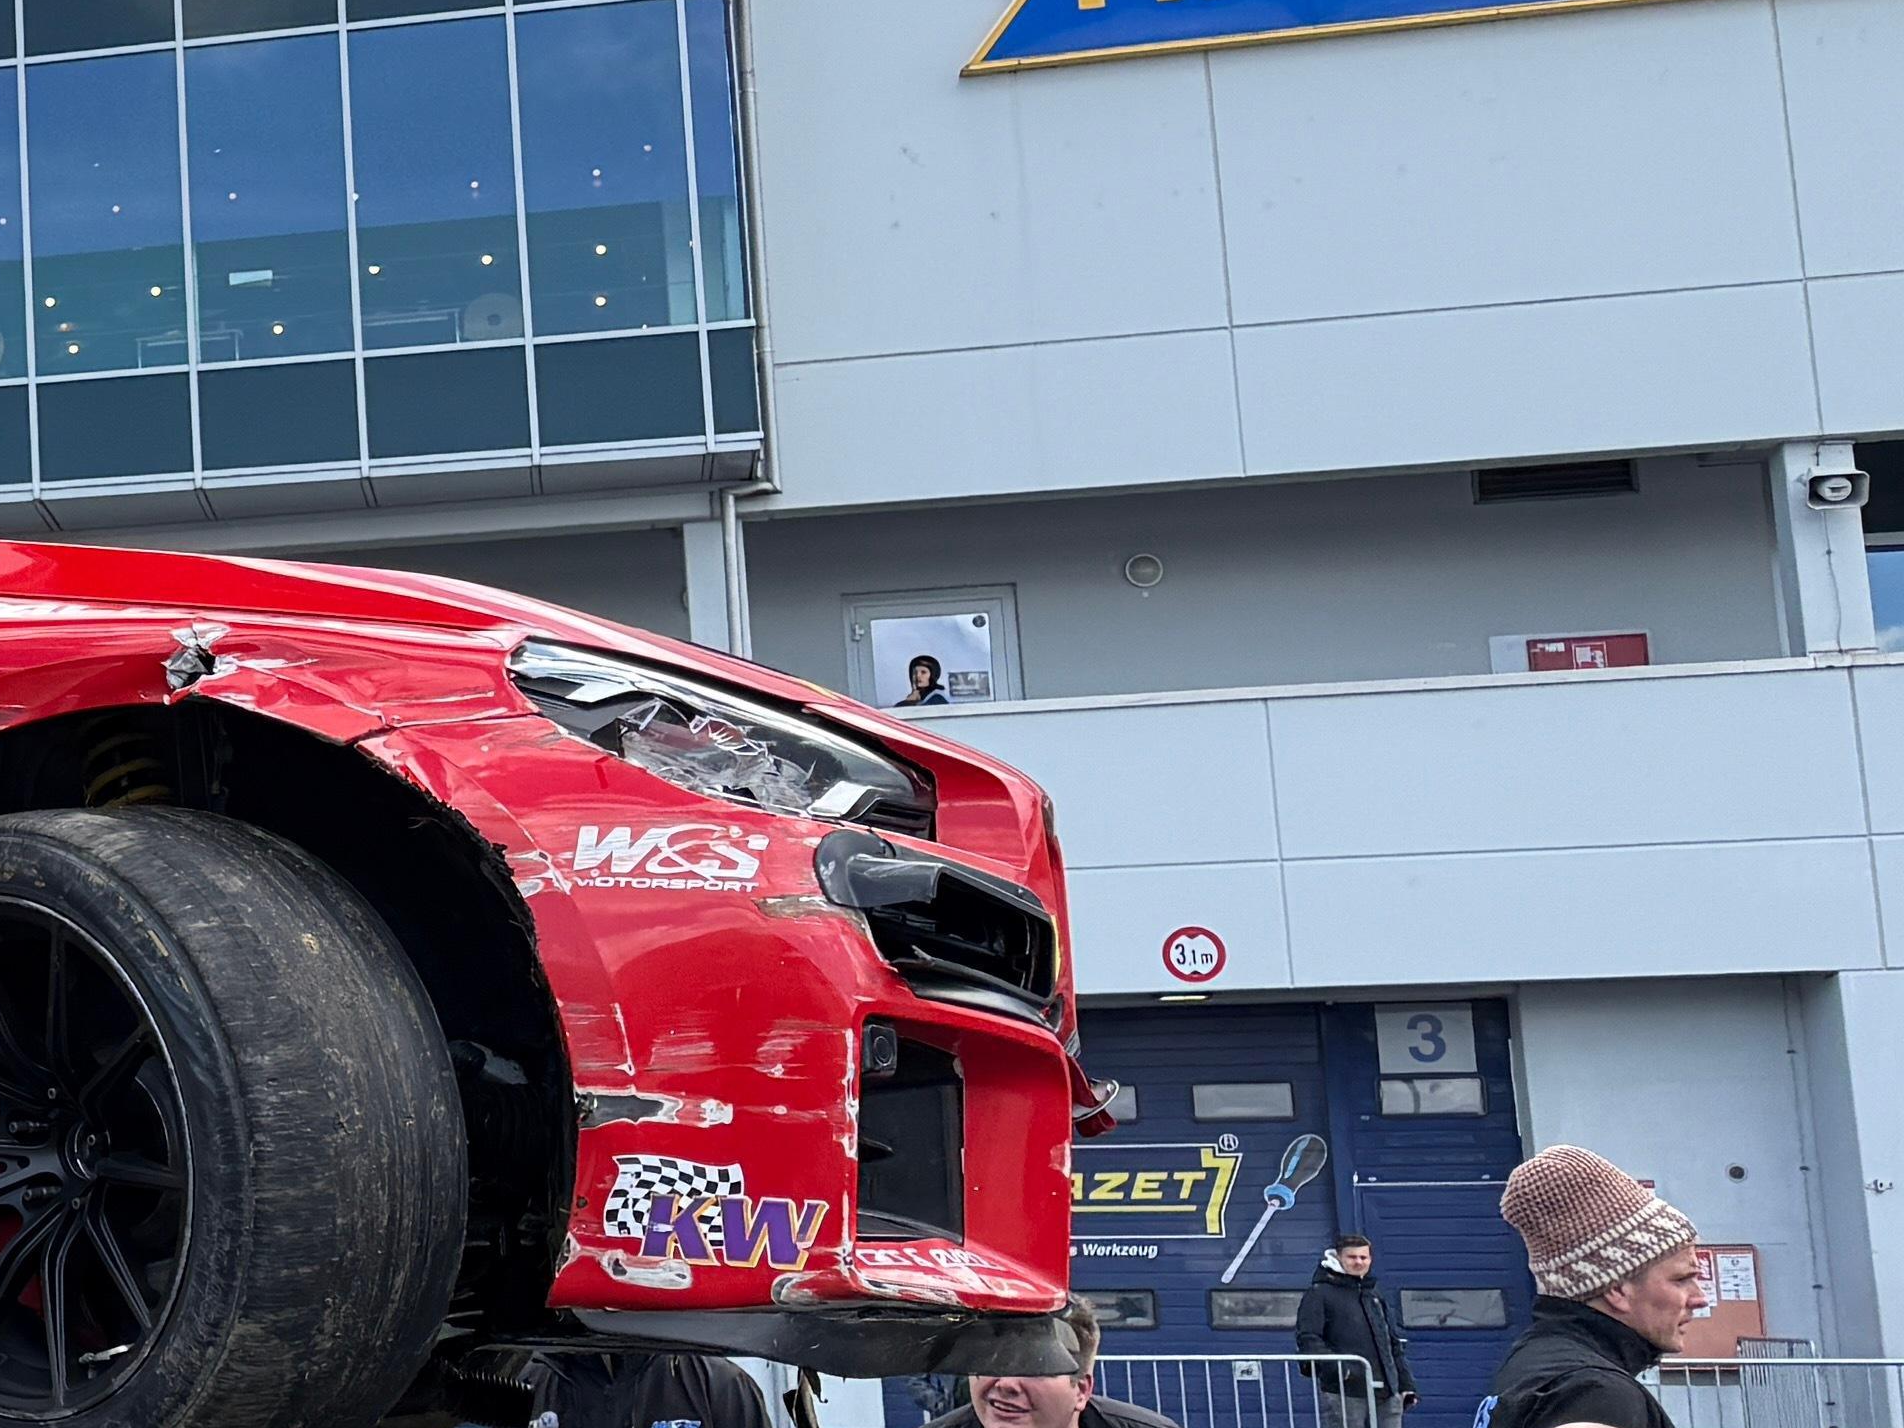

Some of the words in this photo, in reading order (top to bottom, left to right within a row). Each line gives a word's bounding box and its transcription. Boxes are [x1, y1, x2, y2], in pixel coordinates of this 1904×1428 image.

[1407, 1012, 1446, 1066] 3
[640, 1193, 830, 1272] KW
[1082, 1243, 1159, 1260] Werkzeug
